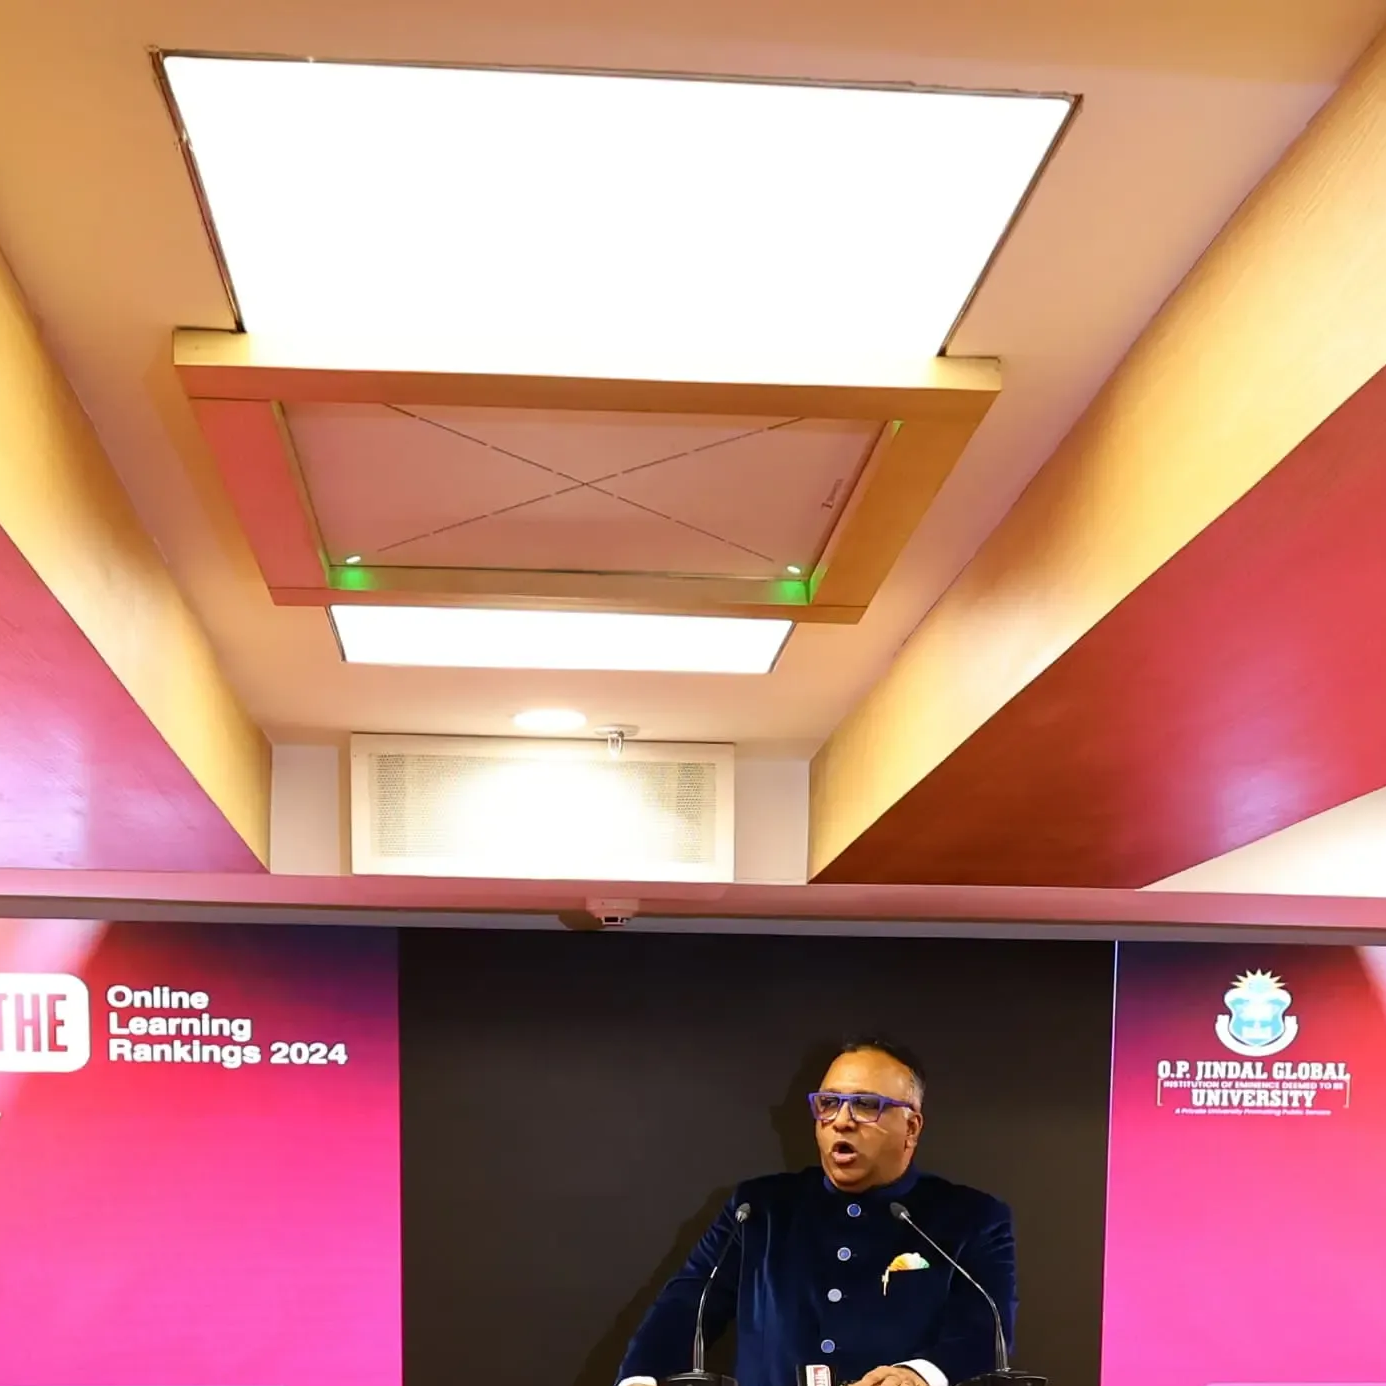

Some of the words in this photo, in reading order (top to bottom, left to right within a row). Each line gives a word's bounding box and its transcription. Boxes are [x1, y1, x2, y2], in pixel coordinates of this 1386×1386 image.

[107, 985, 209, 1009] Online
[110, 1012, 251, 1042] Learning
[109, 1039, 261, 1068] Rankings
[270, 1042, 347, 1064] 2024
[1158, 1061, 1190, 1081] O.P.
[1196, 1062, 1268, 1081] JINDAL
[1273, 1062, 1350, 1081] GLOBAL
[1192, 1089, 1316, 1107] UNIVERSITY
